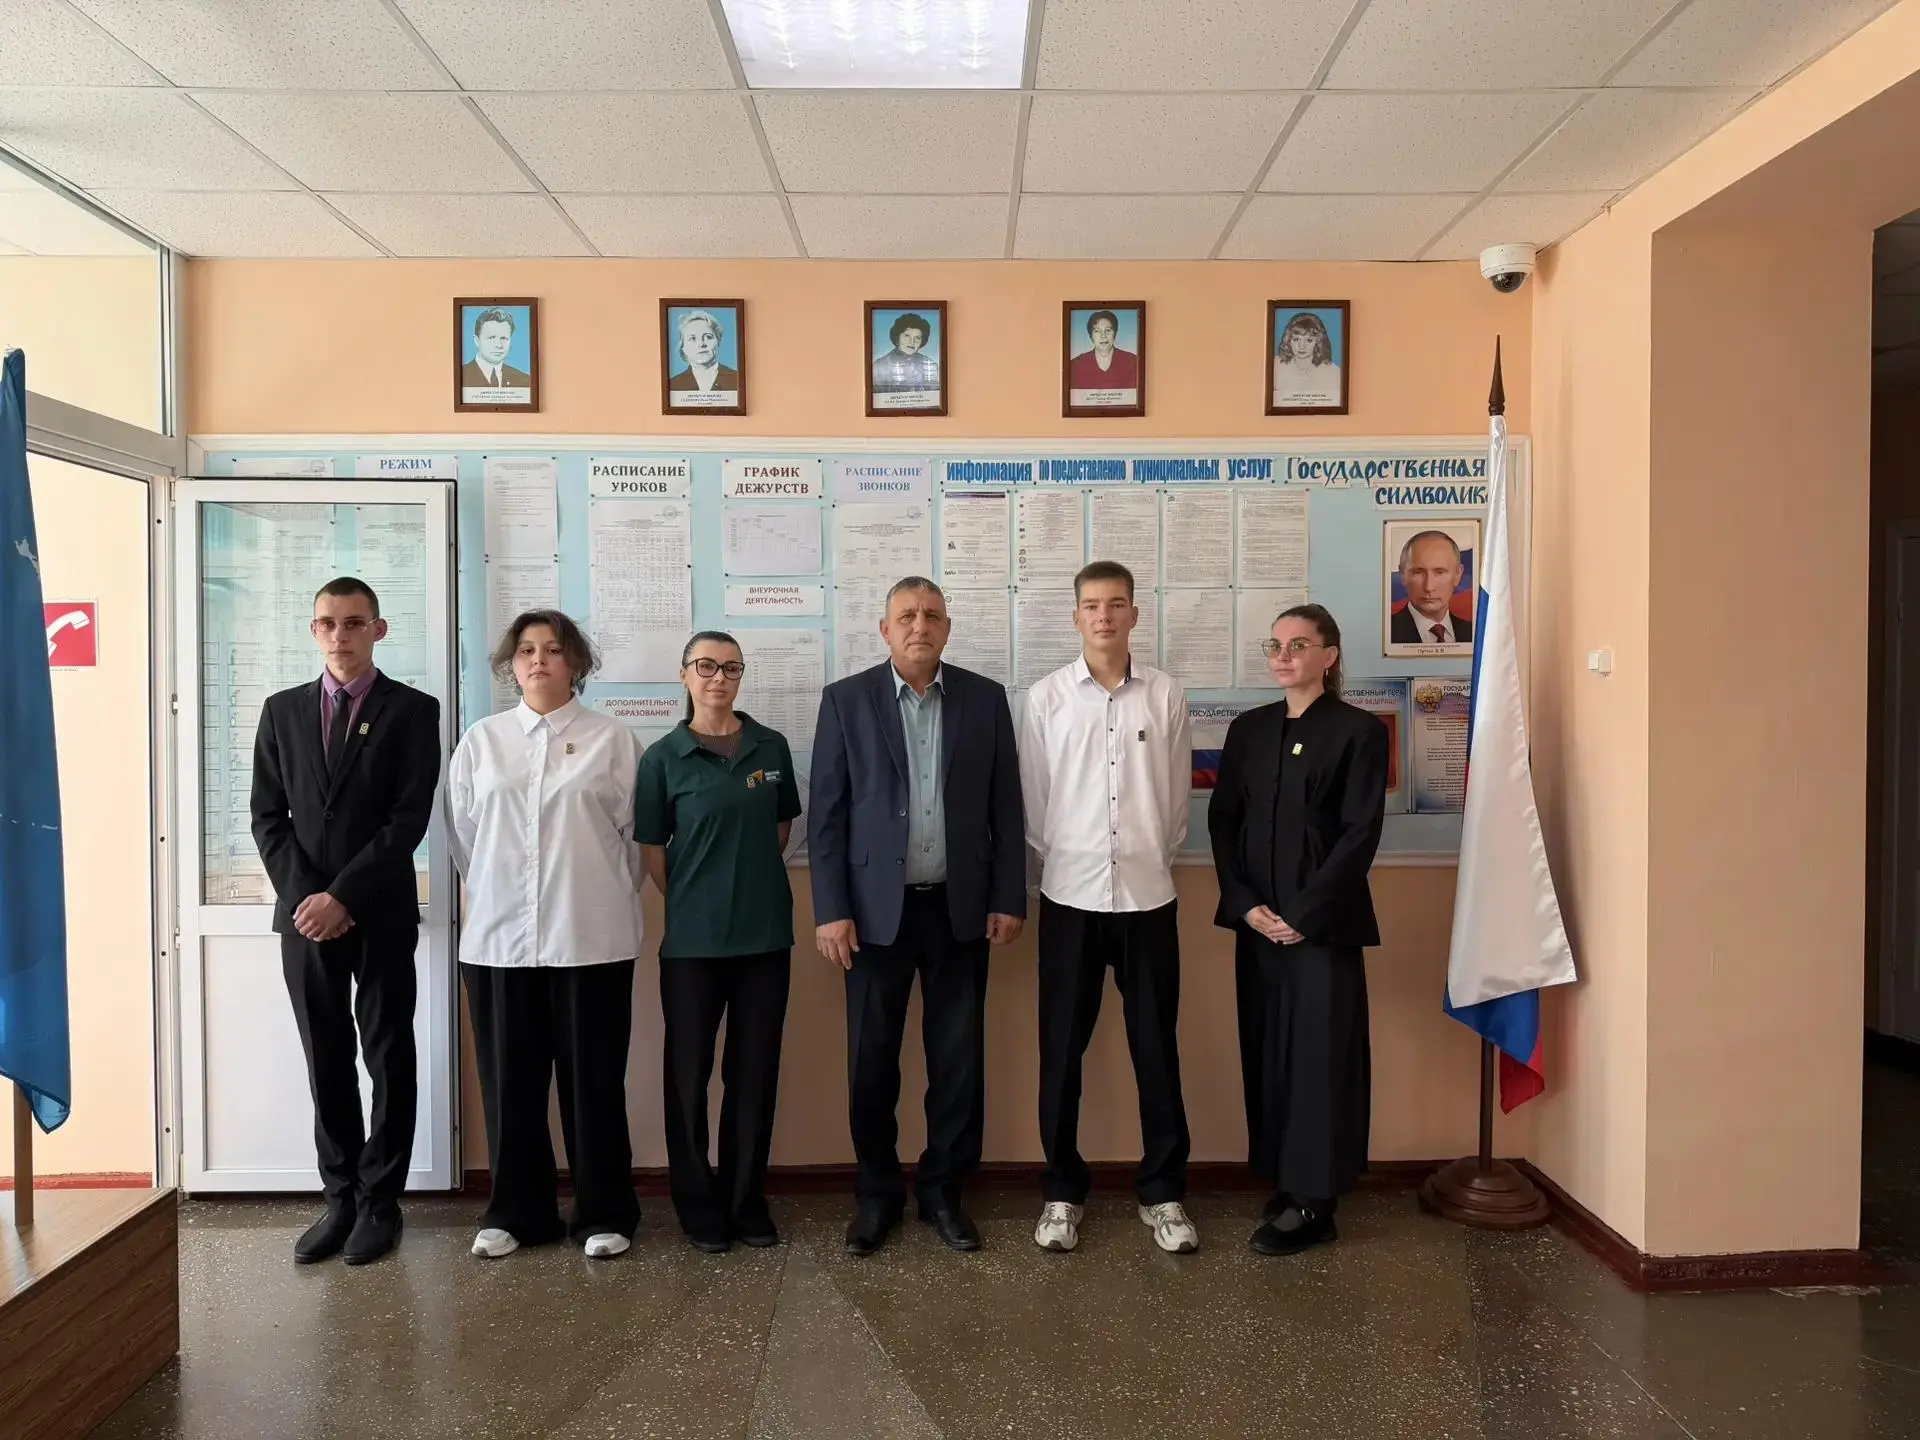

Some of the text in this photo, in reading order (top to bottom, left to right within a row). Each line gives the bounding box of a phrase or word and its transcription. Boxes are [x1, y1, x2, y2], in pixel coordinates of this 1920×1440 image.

[380, 459, 432, 469] РЕЖИМ
[593, 465, 686, 477] РАСПИСАНИЕ
[744, 467, 800, 477] ГРАФИК
[845, 467, 923, 477] РАСПИСАНИЕ
[1287, 457, 1486, 488] Государственная
[611, 482, 667, 493] УРОКОВ
[735, 483, 809, 496] ДЕЖУРСТВ
[858, 482, 911, 491] ЗВОНКОВ
[1375, 486, 1488, 505] символик
[749, 586, 799, 594] ВНЕУРОЧНАЯ
[745, 597, 803, 605] ДЕЯТЕЛЬНОСТЬ
[605, 699, 679, 707] ДОПОЛНИТЕЛЬНОЕ
[614, 709, 671, 717] ОБРАЗОВАНИЕ
